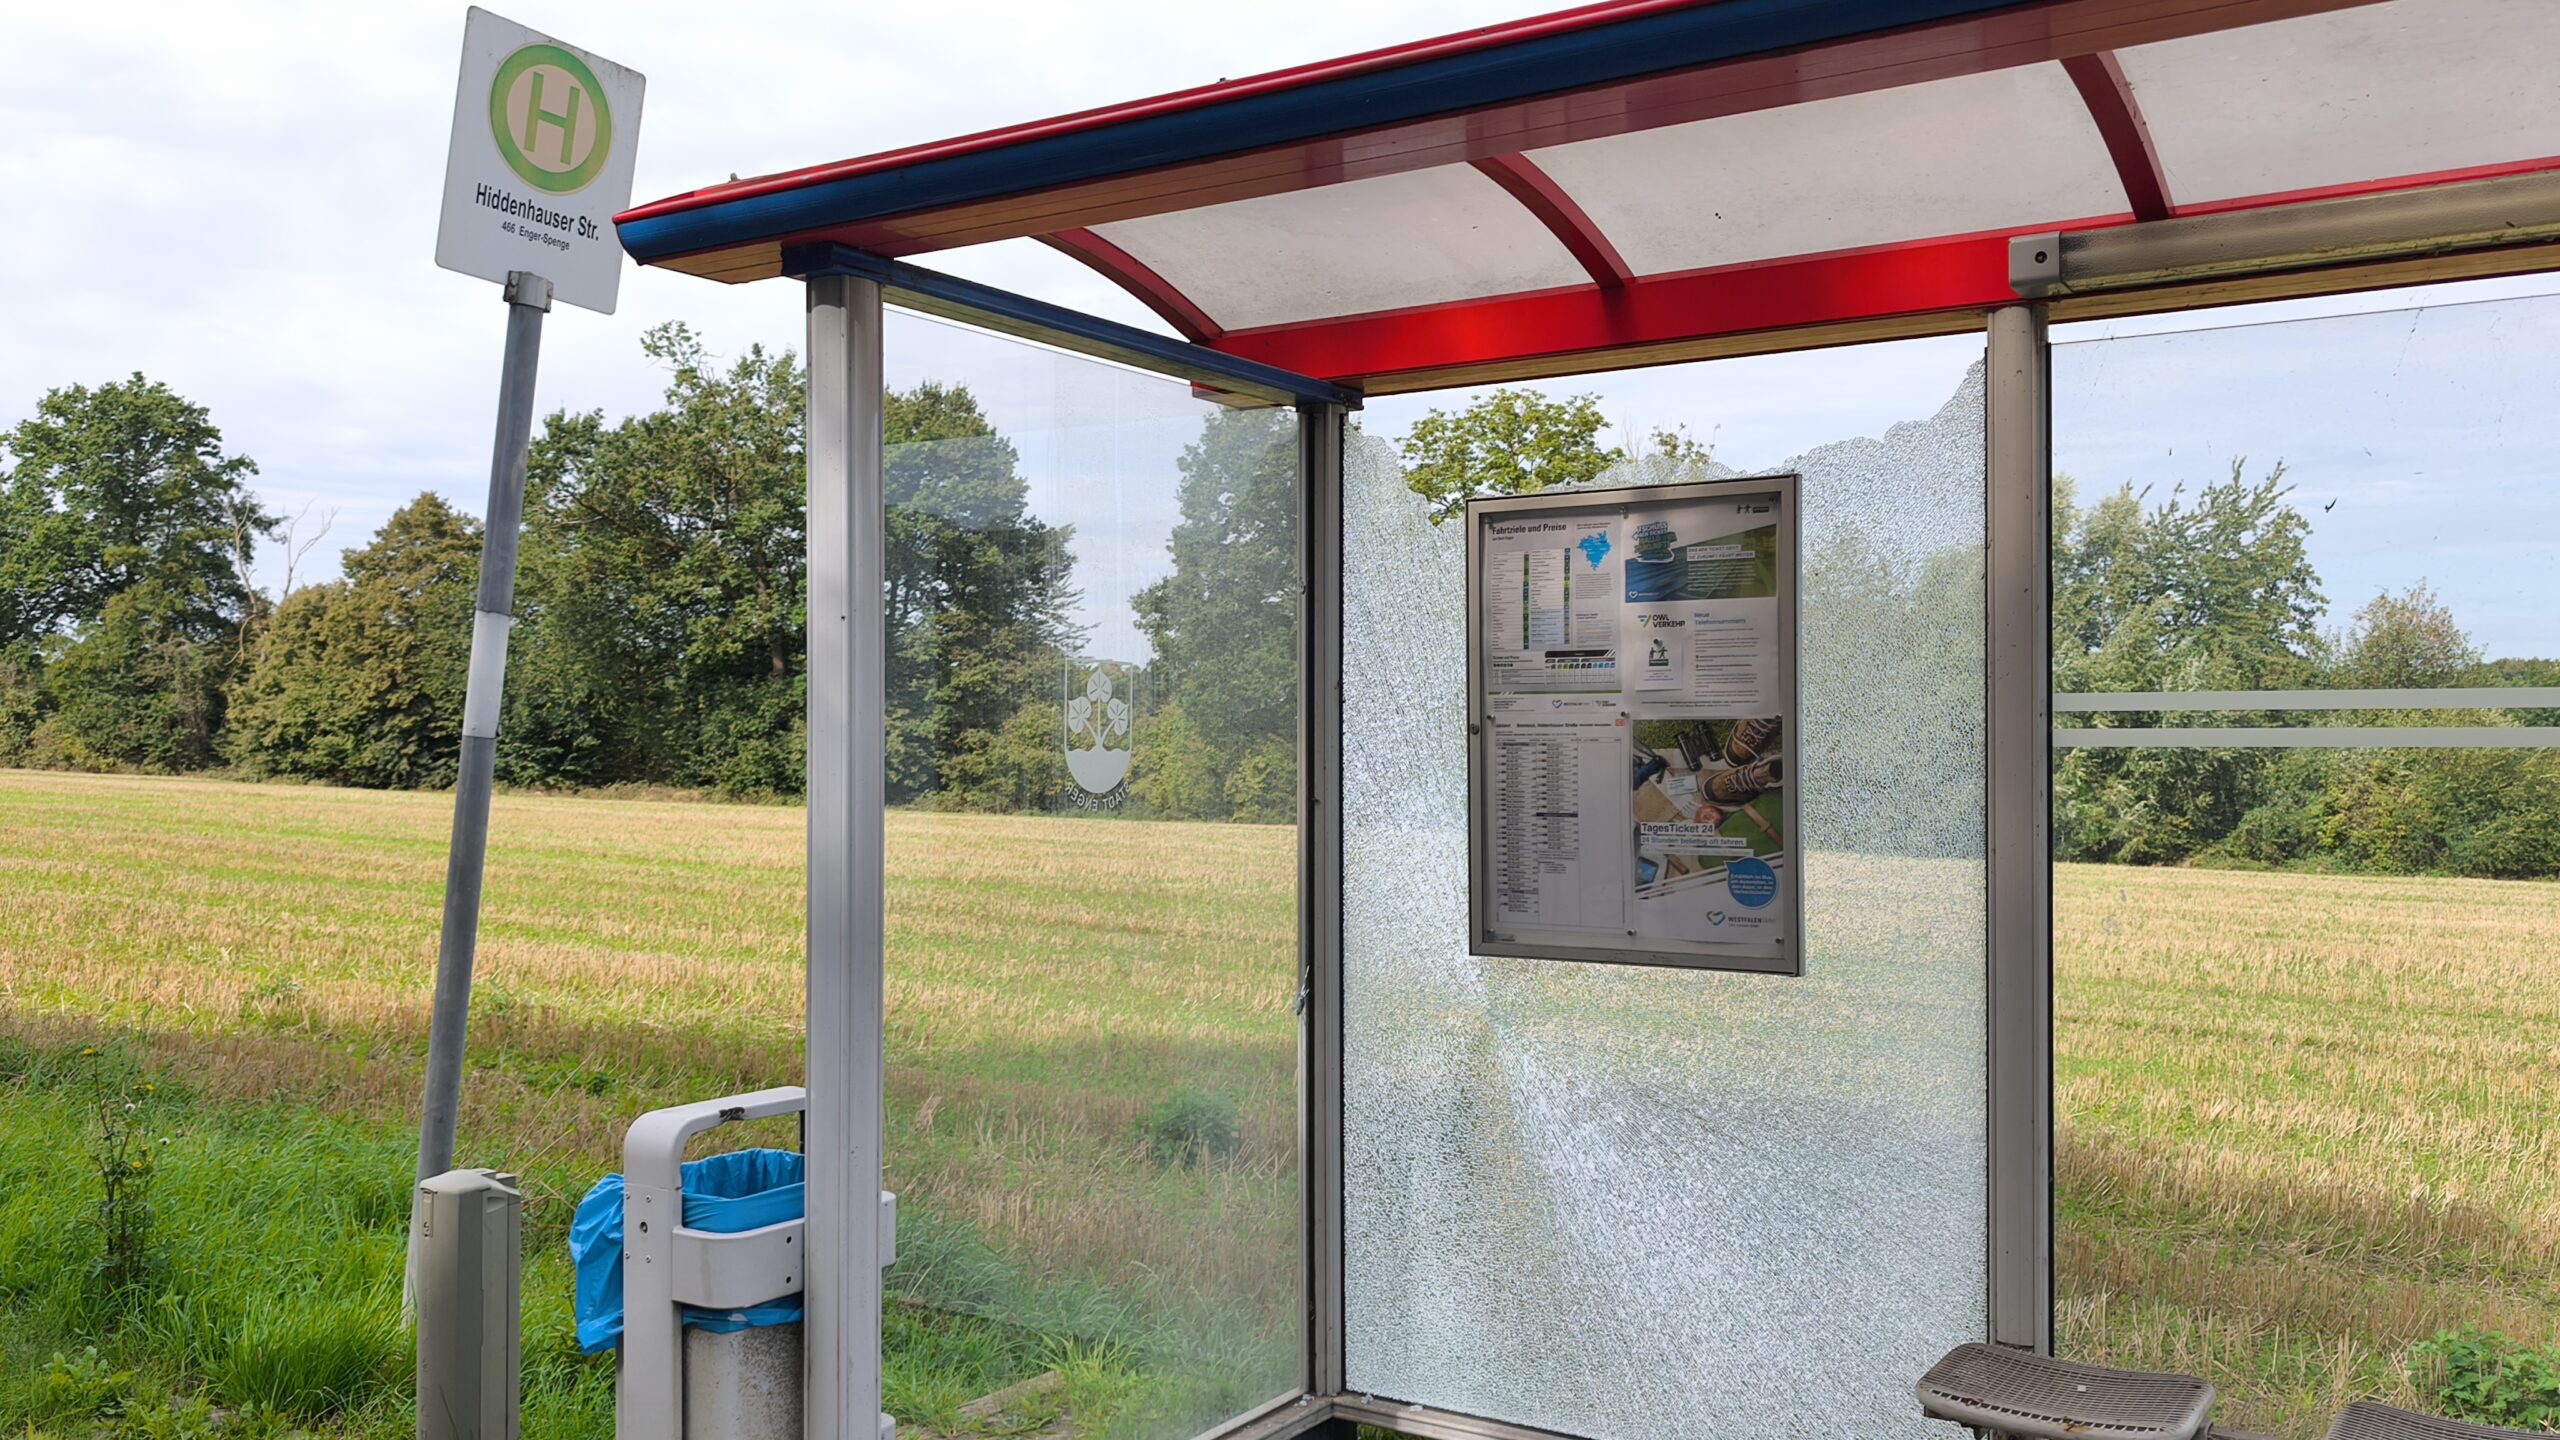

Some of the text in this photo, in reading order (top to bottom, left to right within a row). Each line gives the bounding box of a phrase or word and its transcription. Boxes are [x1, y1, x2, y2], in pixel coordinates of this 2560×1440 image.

[524, 72, 580, 165] H
[476, 183, 600, 240] Hiddenhauser Str.
[502, 221, 570, 250] 466 Enger-Spenge
[1492, 525, 1526, 535] Fahrtziele
[1528, 524, 1541, 532] und
[1543, 523, 1567, 532] Preise
[1652, 620, 1685, 628] VERKEHR
[1642, 824, 1713, 834] TagesTicket 24
